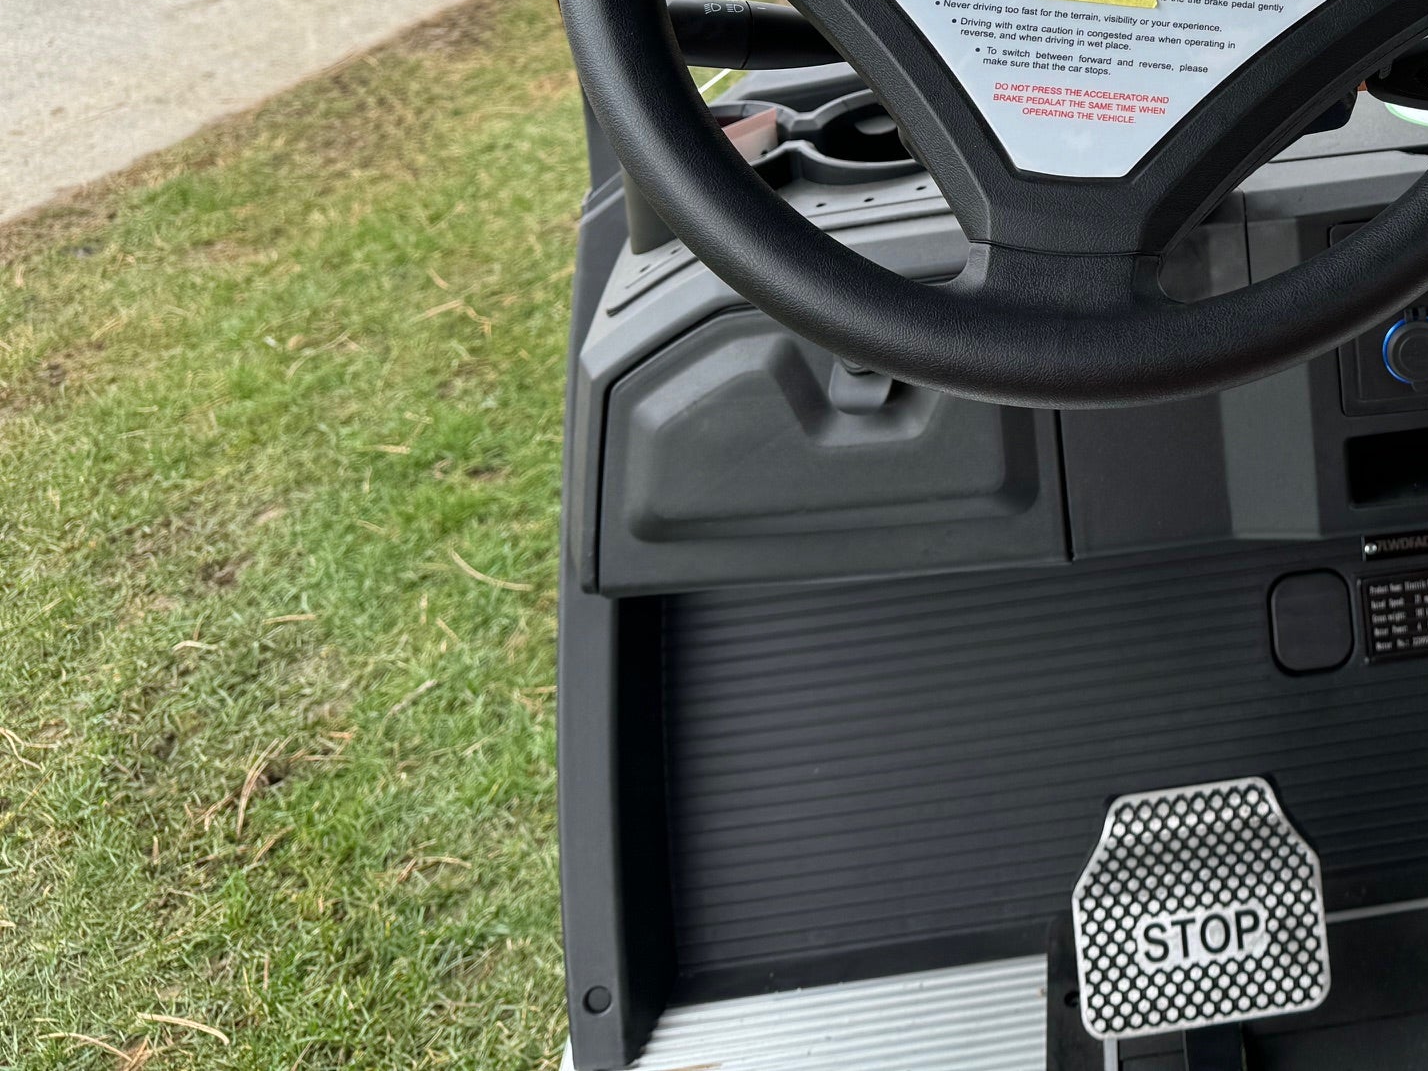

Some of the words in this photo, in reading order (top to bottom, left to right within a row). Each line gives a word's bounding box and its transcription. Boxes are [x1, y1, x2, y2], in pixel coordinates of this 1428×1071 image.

[943, 0, 972, 10] Never
[972, 2, 1003, 15] driving
[1005, 5, 1020, 15] too
[1021, 6, 1039, 17] fast
[1040, 8, 1054, 18] for
[1054, 10, 1069, 20] the
[1070, 11, 1102, 23] terrain,
[1103, 14, 1139, 27] visibility
[1151, 20, 1172, 29] your
[1172, 21, 1223, 33] experience.
[1231, 0, 1256, 10] pedal
[1257, 3, 1285, 14] gently
[960, 17, 993, 30] Driving
[995, 21, 1014, 31] with
[1015, 24, 1039, 33] extra
[1041, 26, 1074, 36] caution
[1076, 28, 1085, 37] in
[1086, 30, 1134, 41] congested
[1135, 34, 1156, 43] area
[1158, 35, 1183, 45] when
[1184, 39, 1226, 51] operating
[1227, 41, 1237, 50] in
[960, 29, 997, 40] reverse,
[999, 32, 1018, 41] and
[1018, 33, 1044, 43] when
[1044, 35, 1076, 48] driving
[1076, 38, 1086, 47] in
[1087, 40, 1104, 49] wet
[1104, 41, 1132, 51] place.
[982, 57, 1009, 67] make
[1010, 60, 1031, 69] sure
[1032, 61, 1050, 71] that
[1051, 62, 1067, 72] the
[1068, 65, 1084, 73] car
[1084, 66, 1112, 77] stops.
[986, 46, 998, 56] To
[1002, 48, 1031, 59] switch
[1035, 50, 1074, 63] between
[1078, 54, 1113, 66] forward
[1116, 59, 1135, 68] and
[1138, 61, 1175, 72] reverse,
[1179, 63, 1209, 74] please
[993, 93, 1025, 104] BRAKE
[1068, 99, 1087, 109] THE
[1088, 101, 1114, 111] SAME
[1116, 103, 1137, 114] TIME
[1138, 106, 1167, 116] WHEN
[994, 82, 1010, 91] DO
[1010, 84, 1031, 93] NOT
[1031, 85, 1063, 96] PRESS
[1064, 88, 1083, 98] THE
[1083, 90, 1150, 103] ACCELERATOR
[1150, 95, 1170, 105] AND
[1022, 107, 1075, 120] OPERATING
[1076, 111, 1095, 121] THE
[1141, 908, 1263, 963] STOP
